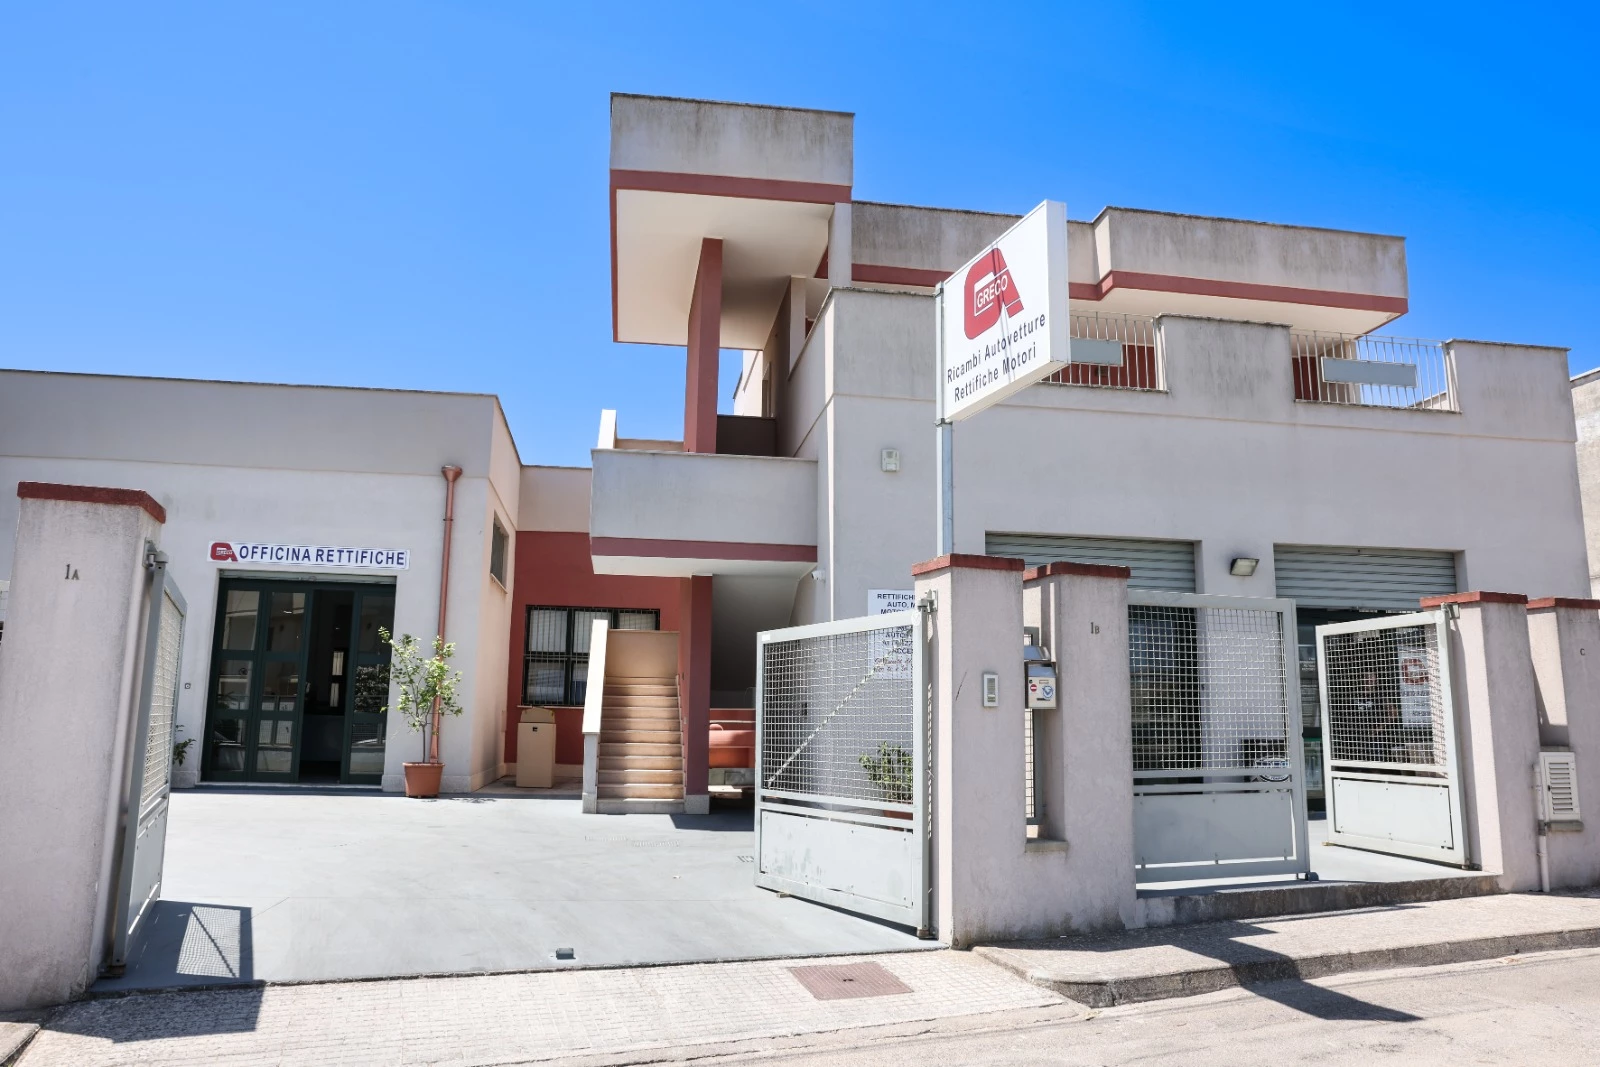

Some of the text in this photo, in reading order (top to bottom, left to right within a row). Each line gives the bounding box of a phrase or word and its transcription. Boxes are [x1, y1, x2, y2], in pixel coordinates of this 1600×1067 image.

[976, 275, 1008, 308] GRECO
[947, 313, 1045, 384] Ricambi Autovetture
[954, 342, 1036, 403] Rettifiche Motori
[239, 545, 311, 562] OFFICINA
[316, 548, 405, 566] RETTIFICHE
[65, 563, 80, 580] 1A
[877, 593, 915, 601] RETTIFICH
[1090, 621, 1100, 635] 1B
